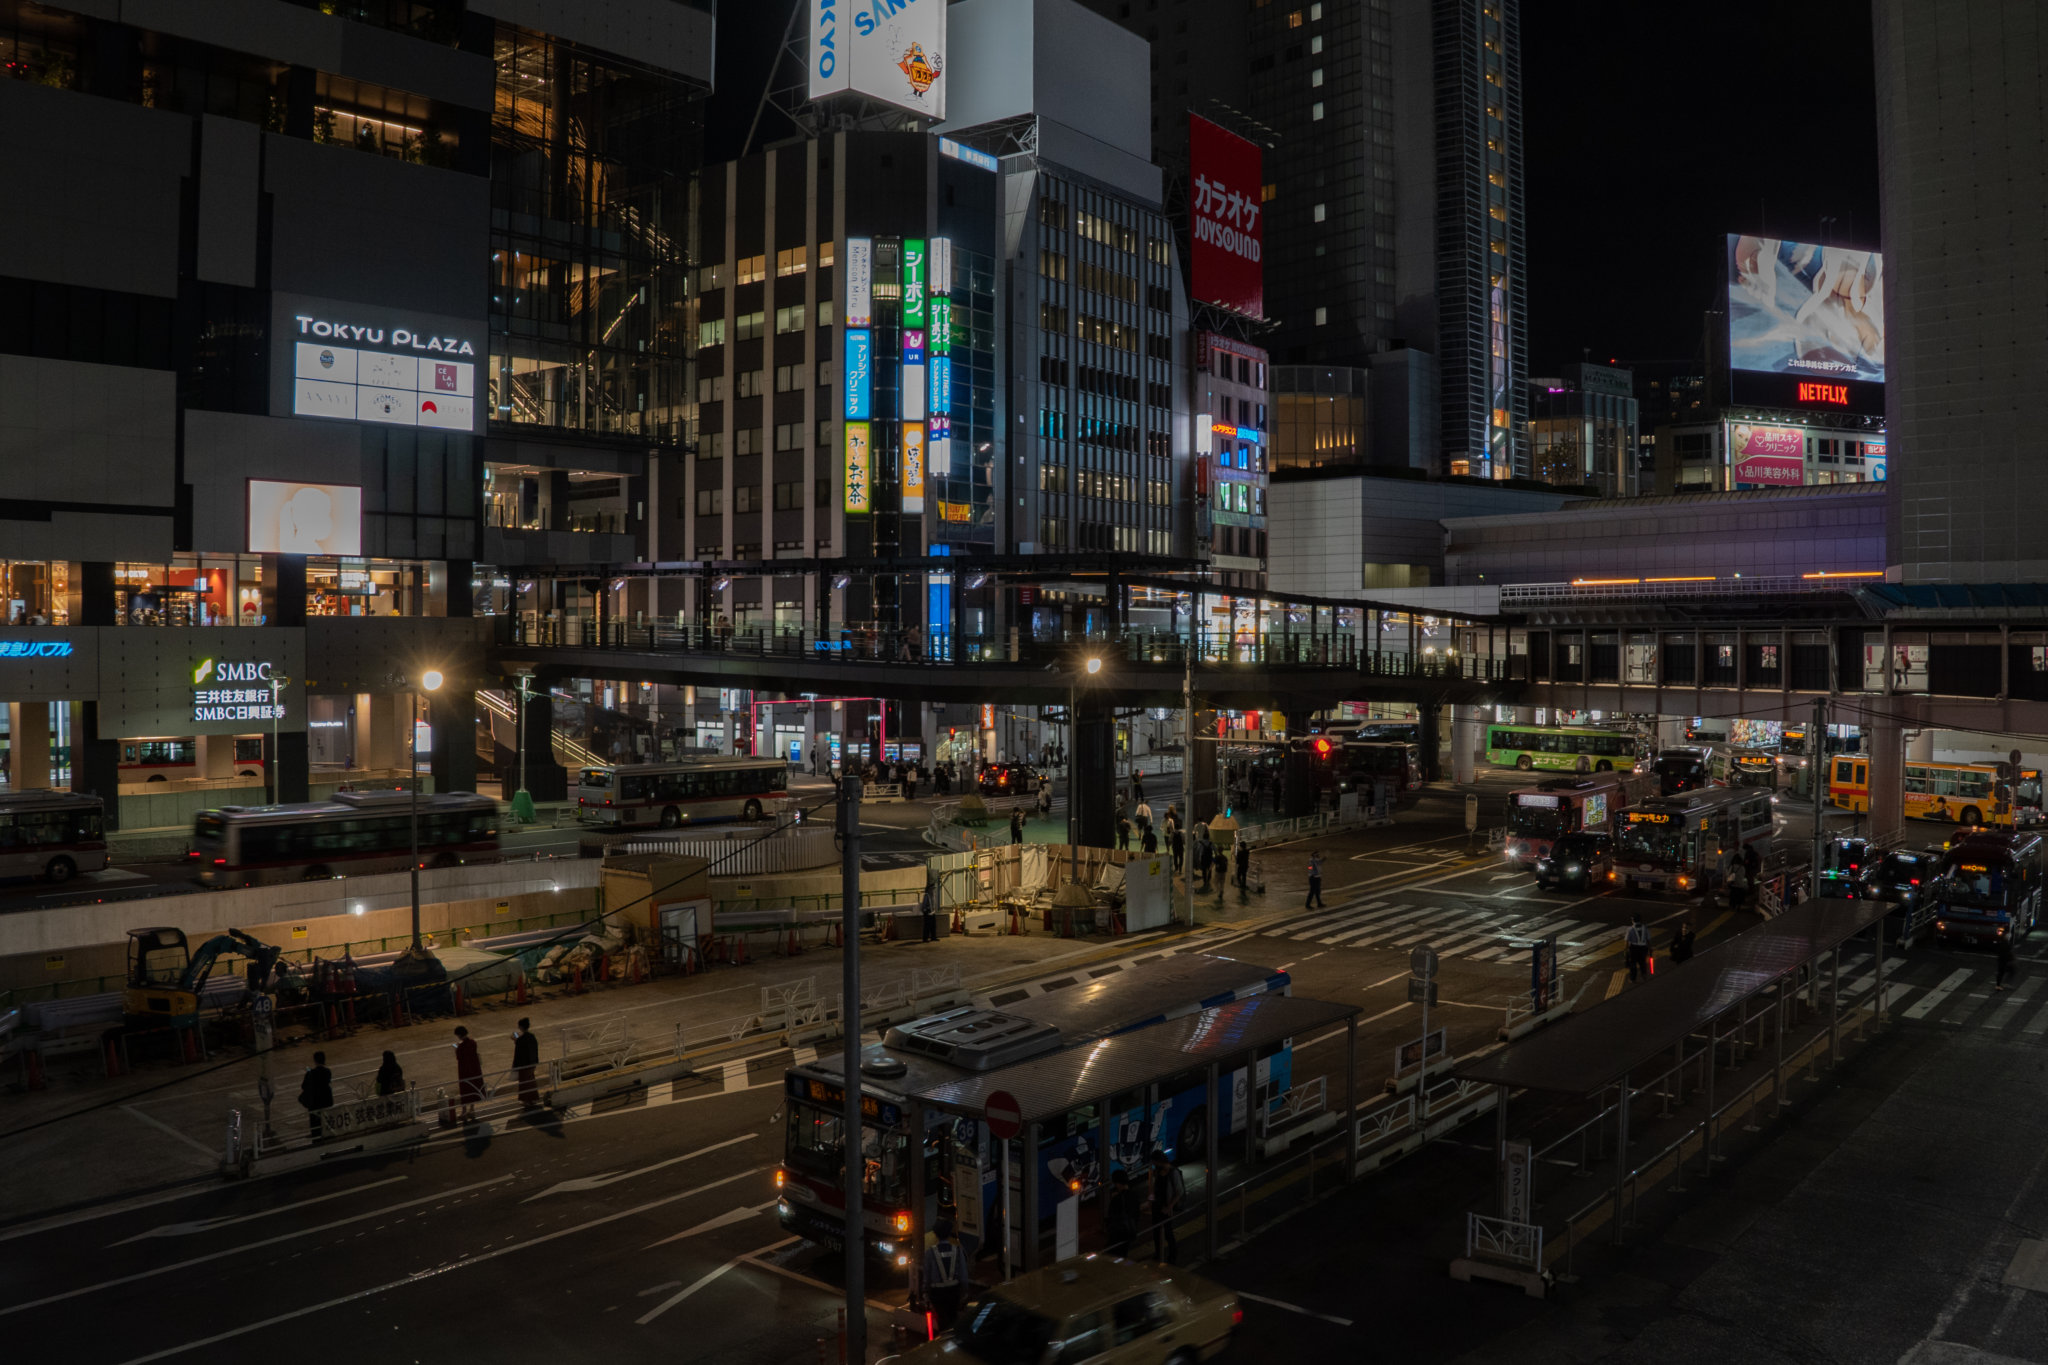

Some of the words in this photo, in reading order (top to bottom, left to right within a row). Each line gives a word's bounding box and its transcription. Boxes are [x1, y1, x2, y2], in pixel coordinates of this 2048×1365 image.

[1194, 173, 1259, 232] カラオケ
[1194, 215, 1261, 263] JOYSOUND
[295, 315, 384, 343] TOKYU
[391, 329, 474, 356] PLAZA
[857, 344, 867, 378] アリシア
[849, 371, 859, 414] クリニック
[1800, 382, 1848, 405] NETFLIX
[1764, 432, 1800, 443] 品川スキン
[1765, 443, 1796, 453] クリニック
[1744, 465, 1800, 481] 品川美容外科
[216, 662, 272, 681] SMBC
[195, 690, 269, 704] 三井住友銀行
[255, 1000, 271, 1012] 48
[958, 1121, 974, 1141] 36
